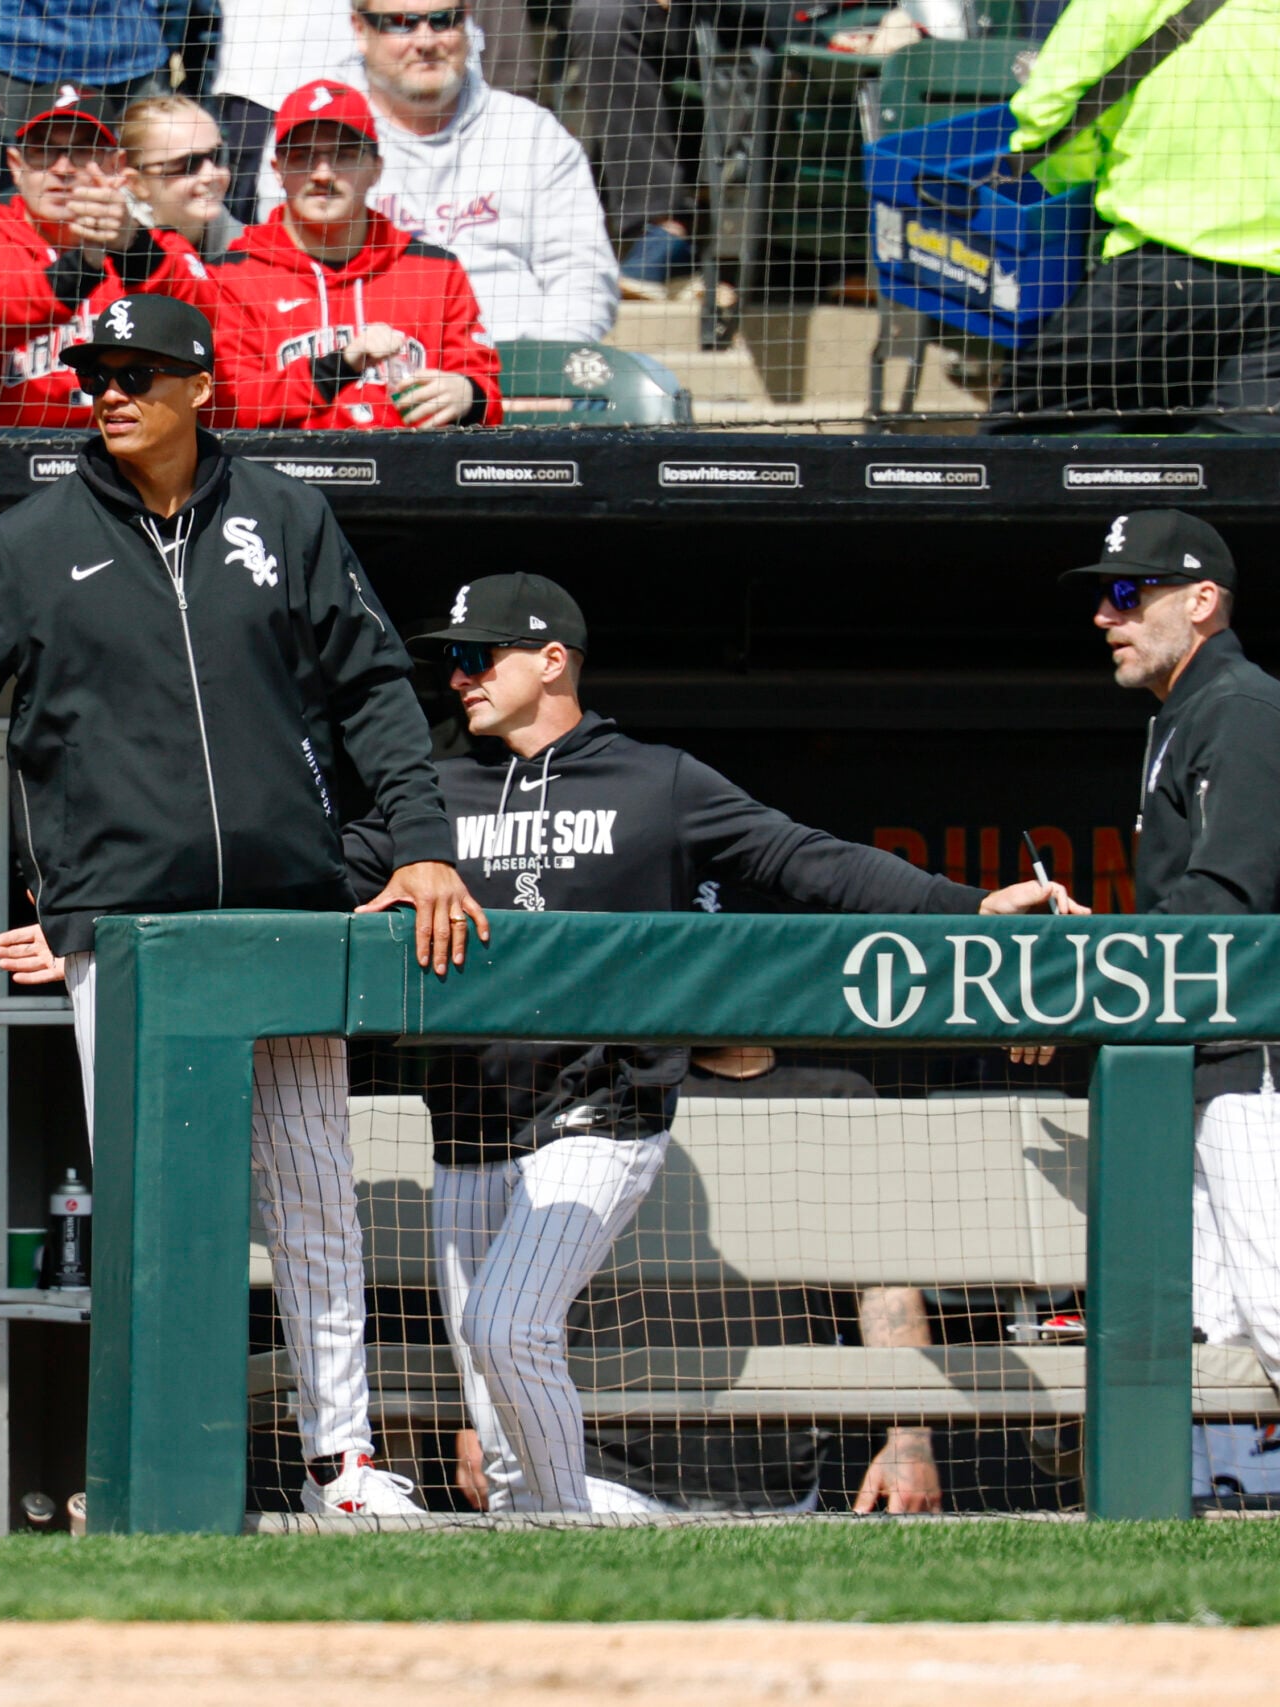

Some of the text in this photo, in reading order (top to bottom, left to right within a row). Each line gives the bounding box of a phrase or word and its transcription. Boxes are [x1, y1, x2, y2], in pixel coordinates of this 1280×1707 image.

[463, 465, 570, 481] whitesox.com
[663, 465, 794, 482] loswhitesox.com
[872, 469, 979, 484] whitesox.com
[1069, 468, 1198, 484] loswhitesox.com
[301, 737, 322, 786] WHITE
[456, 809, 617, 860] WHITE SOX
[945, 932, 1238, 1025] RUSH
